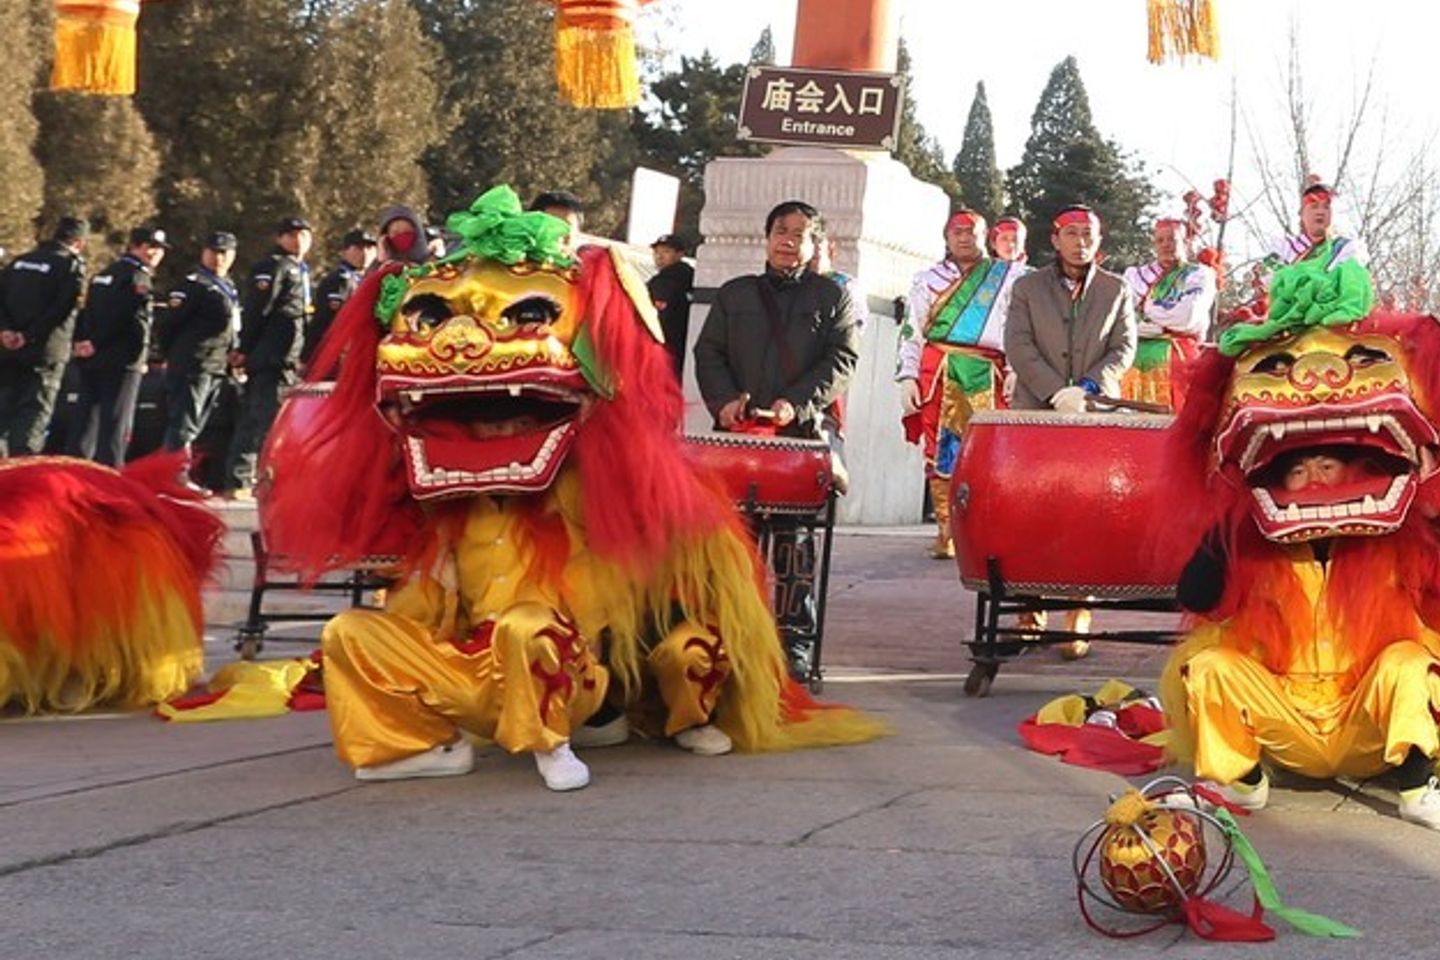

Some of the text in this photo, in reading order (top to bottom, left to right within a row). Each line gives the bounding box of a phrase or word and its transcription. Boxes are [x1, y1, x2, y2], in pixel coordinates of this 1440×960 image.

[761, 77, 884, 116] 庙会入口
[781, 118, 855, 136] Entrance
